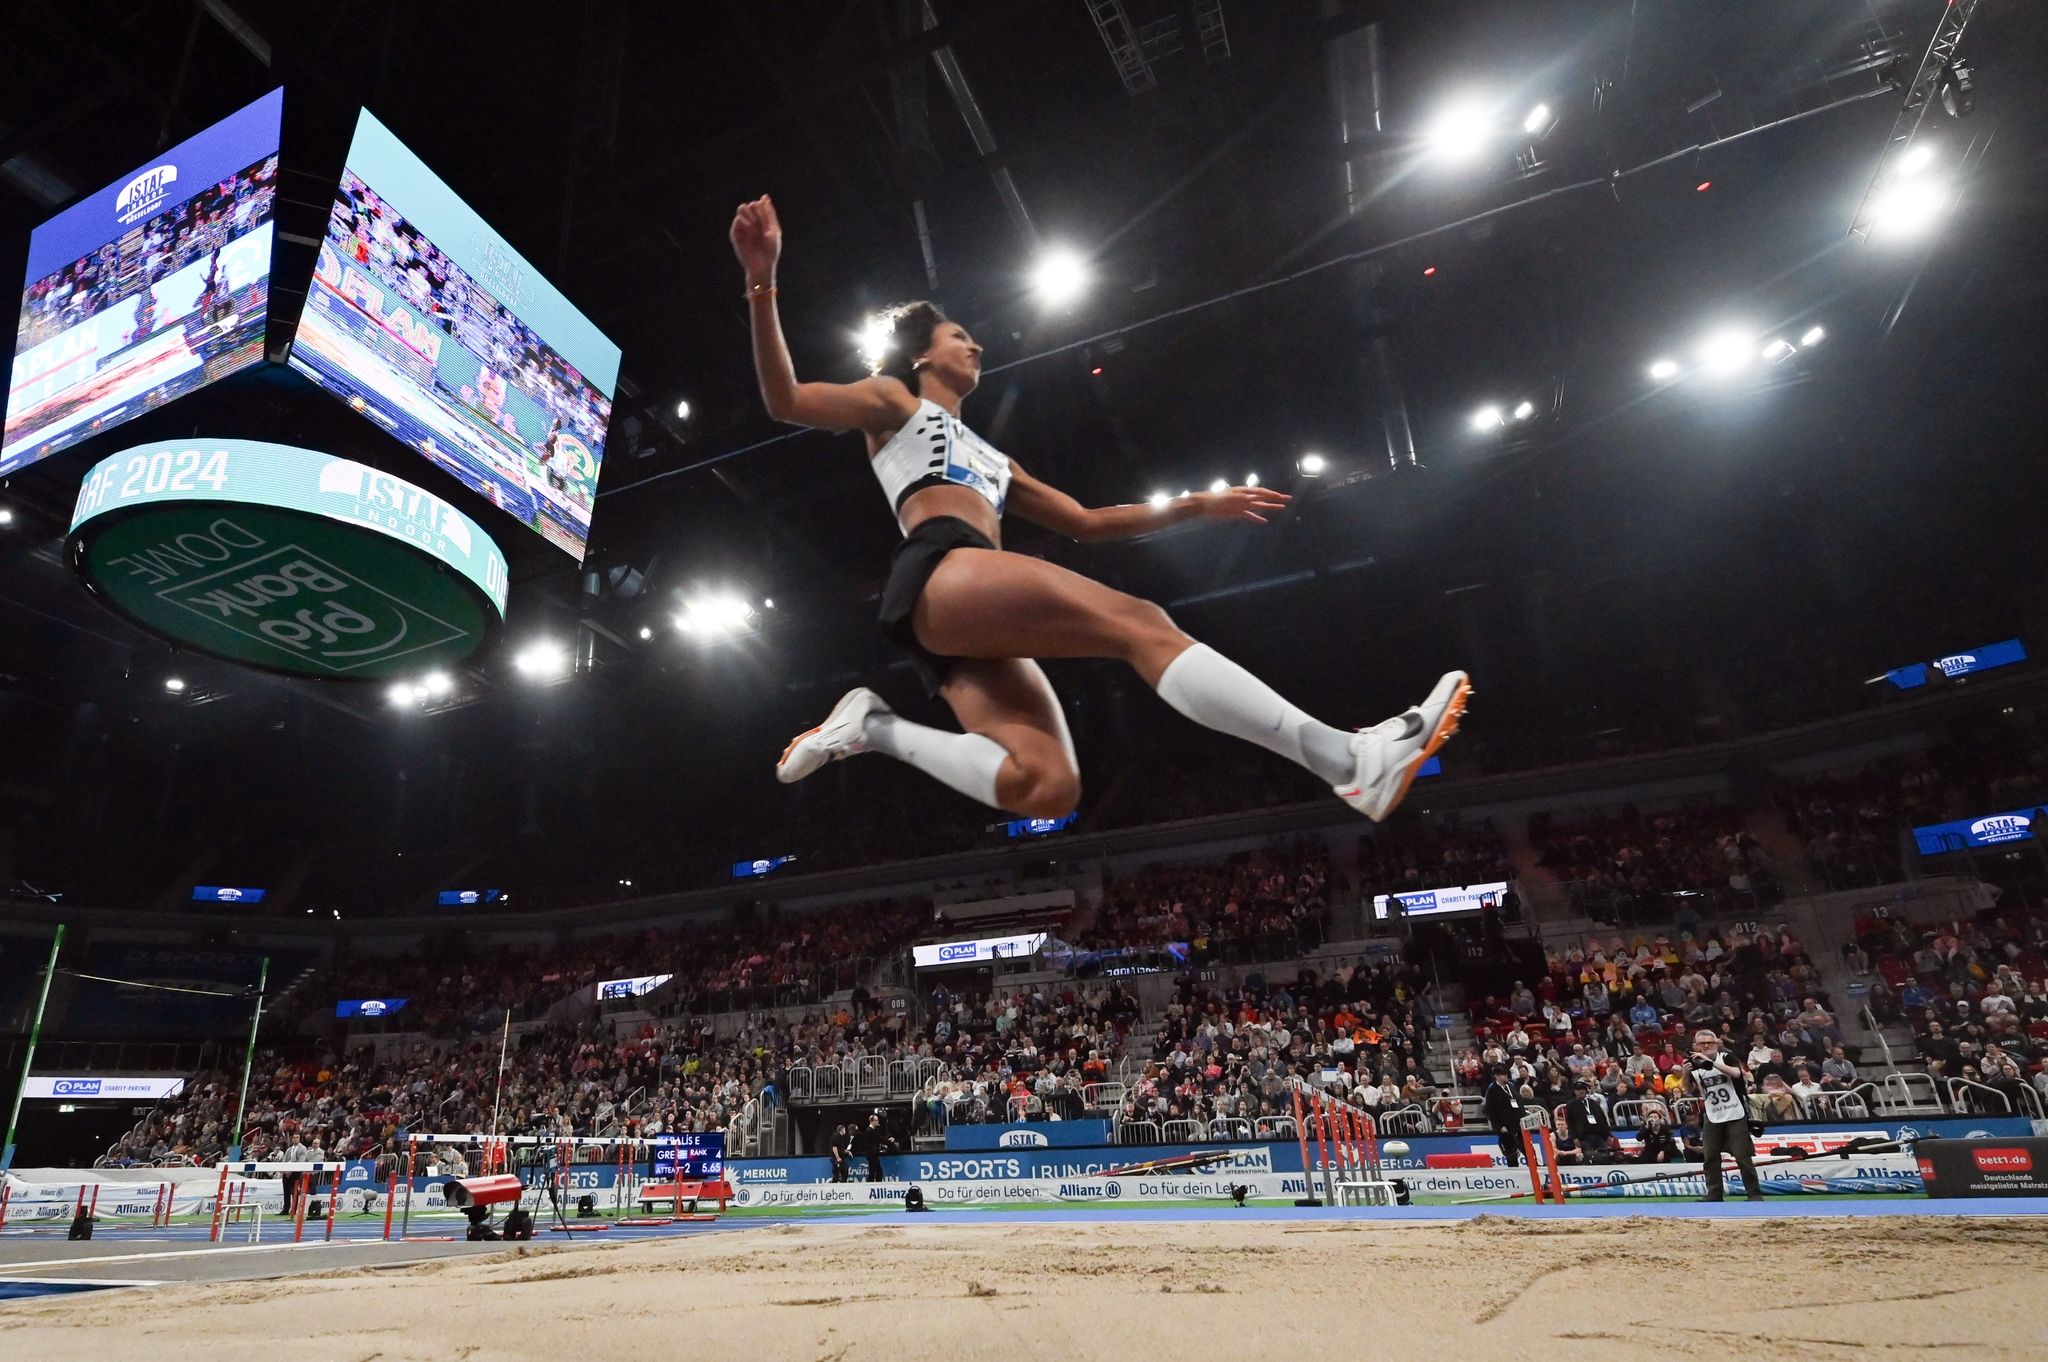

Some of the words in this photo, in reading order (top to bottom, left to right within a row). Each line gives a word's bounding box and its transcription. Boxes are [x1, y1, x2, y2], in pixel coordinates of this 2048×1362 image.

[128, 169, 165, 204] ISTAF
[121, 450, 229, 499] 2024
[357, 471, 449, 535] ISTAF
[354, 505, 447, 551] INDOOR
[106, 518, 267, 585] DOME
[184, 559, 350, 617] Bank
[1982, 817, 2016, 831] ISTAF
[1406, 897, 1434, 906] PLAN
[954, 946, 975, 954] PLAN
[1200, 970, 1216, 981] 011
[73, 1082, 99, 1091] PLAN
[1706, 1088, 1731, 1105] 39
[695, 1136, 700, 1145] E
[1009, 1133, 1037, 1146] ISTAF
[657, 1150, 675, 1160] GRE
[689, 1148, 708, 1156] RANK
[715, 1150, 722, 1159] 4
[1979, 1155, 2027, 1164] bett1.de
[350, 1169, 366, 1178] ISTAF
[685, 1163, 690, 1173] 2
[701, 1162, 721, 1173] 5.65
[743, 1168, 787, 1179] MERKUR
[920, 1159, 1020, 1179] D.SPORTS
[1426, 1176, 1456, 1190] dein
[1465, 1175, 1520, 1190] Leben.
[1970, 1183, 2019, 1191] meistgeliebte
[763, 1191, 778, 1201] Da
[780, 1189, 794, 1201] für
[796, 1190, 818, 1201] dein
[820, 1190, 854, 1201] Leben.
[869, 1188, 907, 1199] Allianz
[938, 1187, 954, 1199] Da
[958, 1186, 973, 1198] für
[976, 1186, 1001, 1198] dein
[1004, 1185, 1043, 1197] Leben.
[1060, 1184, 1102, 1197] Allianz
[1139, 1183, 1158, 1195] Da
[1162, 1182, 1179, 1195] für
[1183, 1182, 1213, 1195] dein
[1216, 1183, 1261, 1195] Len.
[36, 1206, 60, 1218] Allianz
[115, 1203, 151, 1214] Allianz
